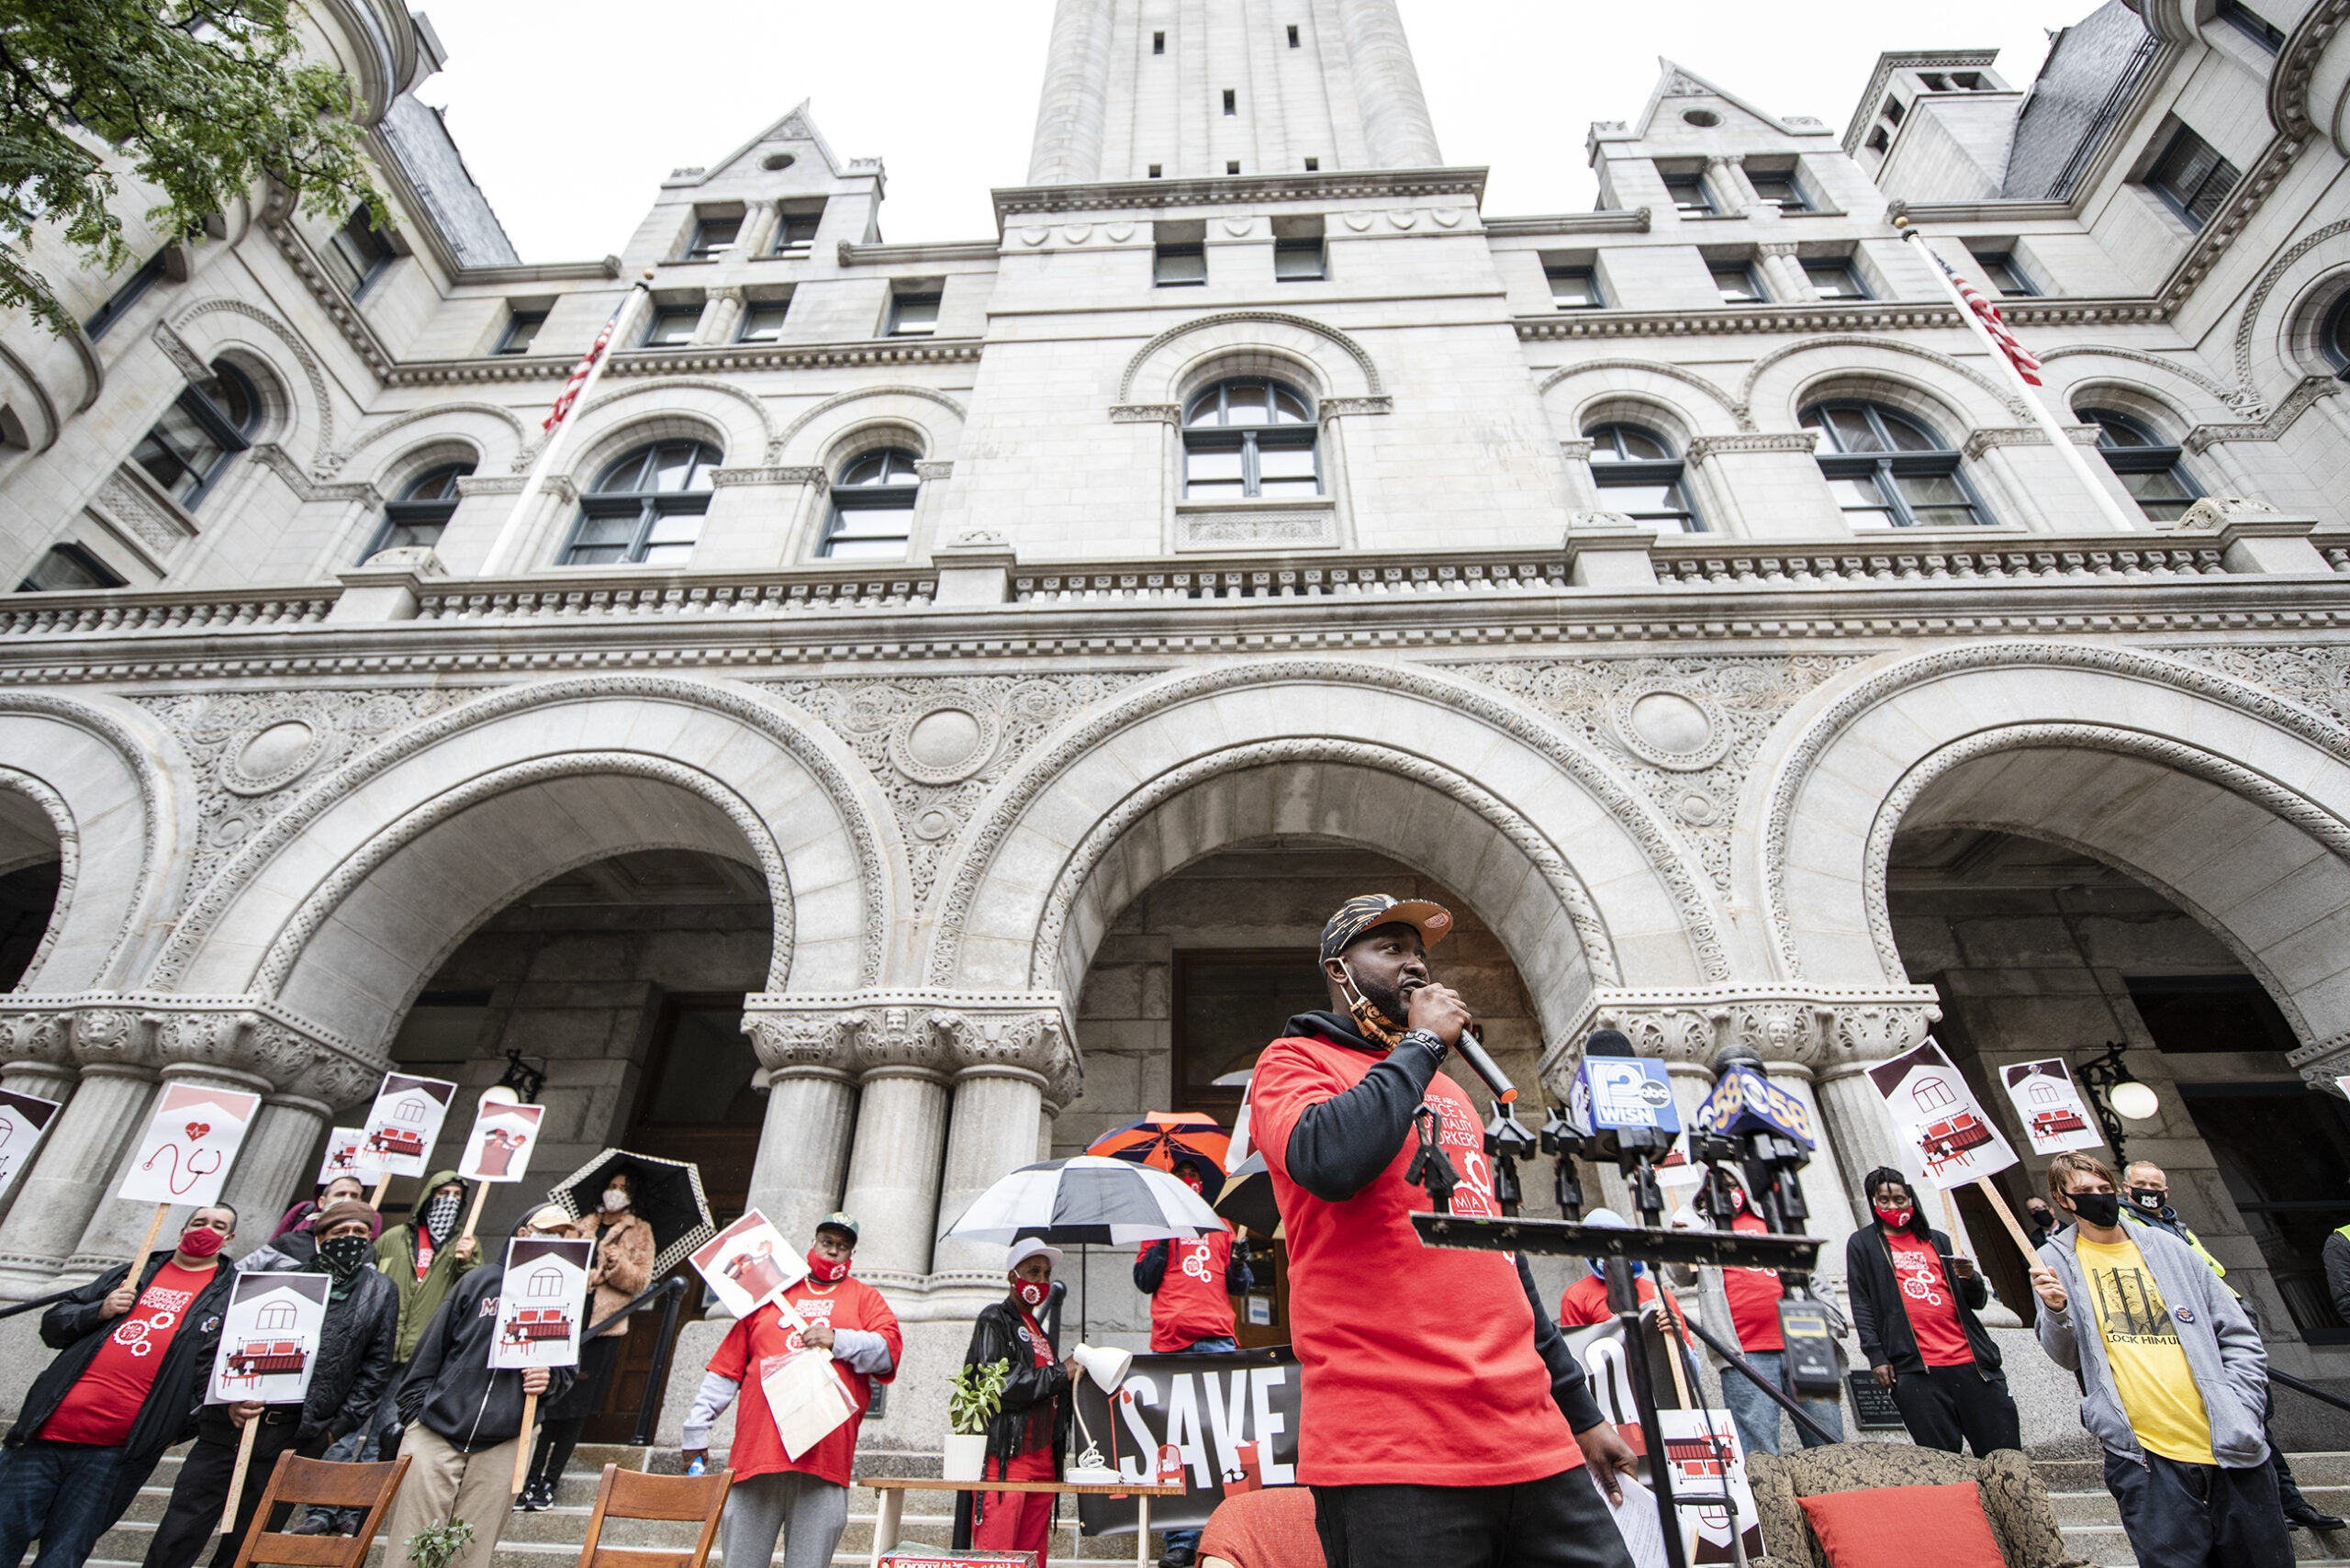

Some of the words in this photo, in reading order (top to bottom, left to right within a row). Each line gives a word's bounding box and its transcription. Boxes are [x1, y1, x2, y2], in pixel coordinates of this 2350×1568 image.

[1639, 1085, 1670, 1100] abc
[1712, 1073, 1742, 1129] 58
[1600, 1106, 1652, 1124] WISN
[1767, 1086, 1814, 1140] 58
[2141, 1195, 2158, 1208] 135
[2106, 1334, 2139, 1345] LOCK
[2141, 1335, 2167, 1346] HIM
[1119, 1366, 1295, 1489] SAVE
